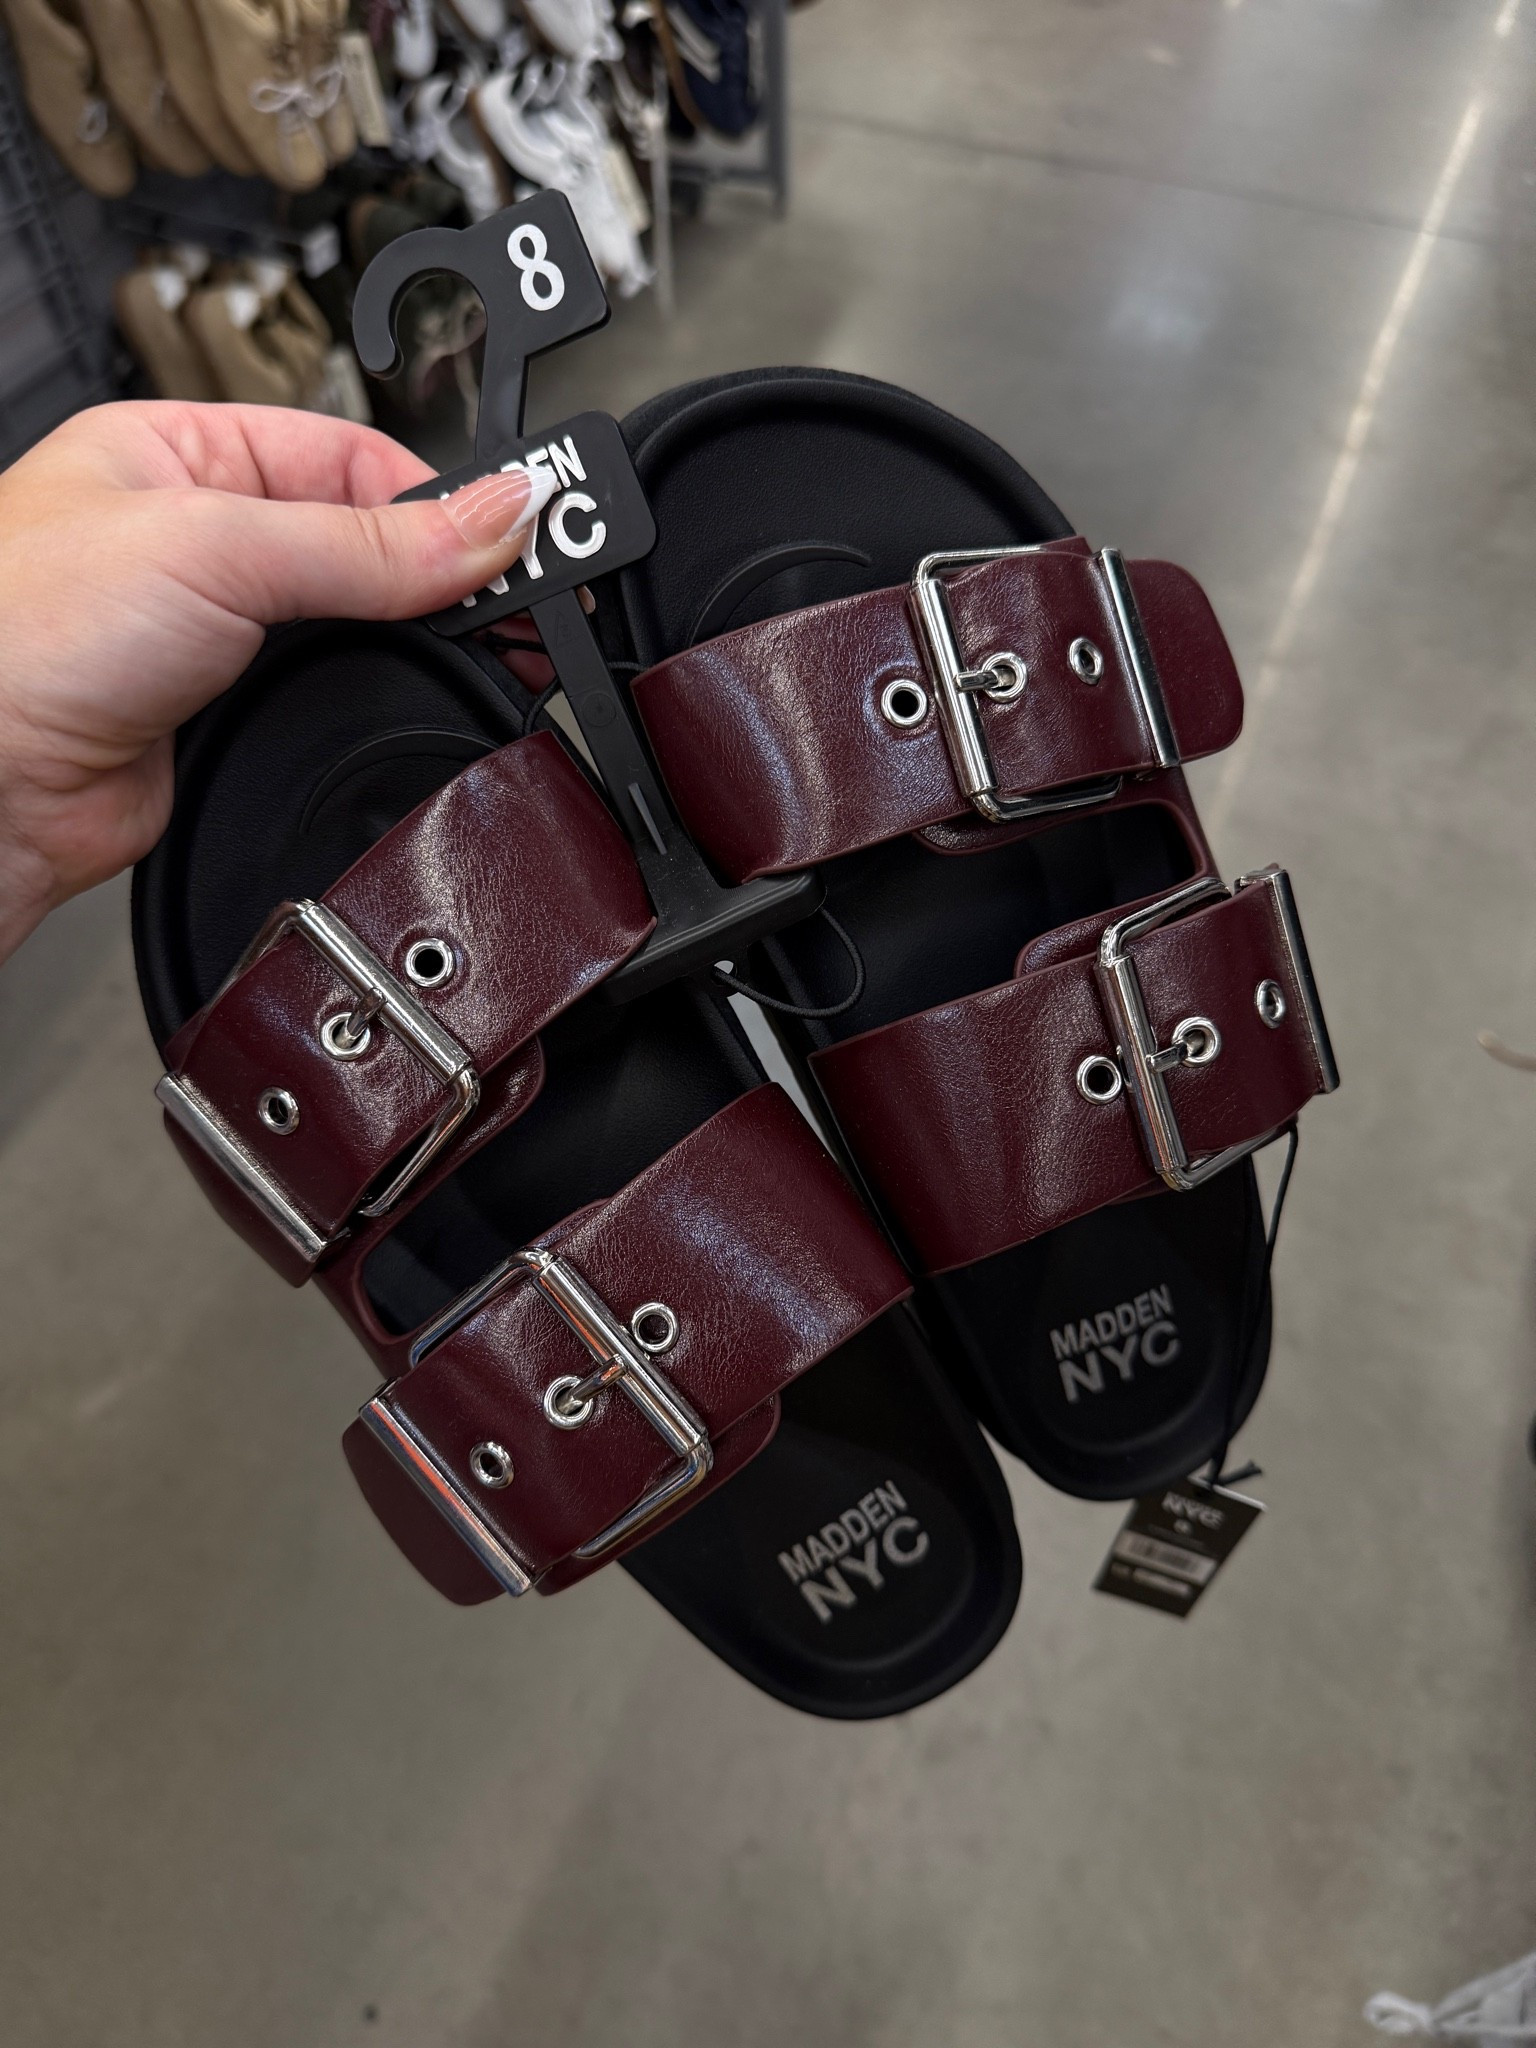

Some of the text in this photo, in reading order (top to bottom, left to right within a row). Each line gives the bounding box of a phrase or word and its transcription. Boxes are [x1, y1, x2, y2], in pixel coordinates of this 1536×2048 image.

[507, 224, 565, 311] 8
[1050, 1283, 1174, 1360] MADDEN
[1059, 1320, 1180, 1404] NYC
[778, 1480, 907, 1584] MADDEN
[801, 1516, 930, 1624] NYC
